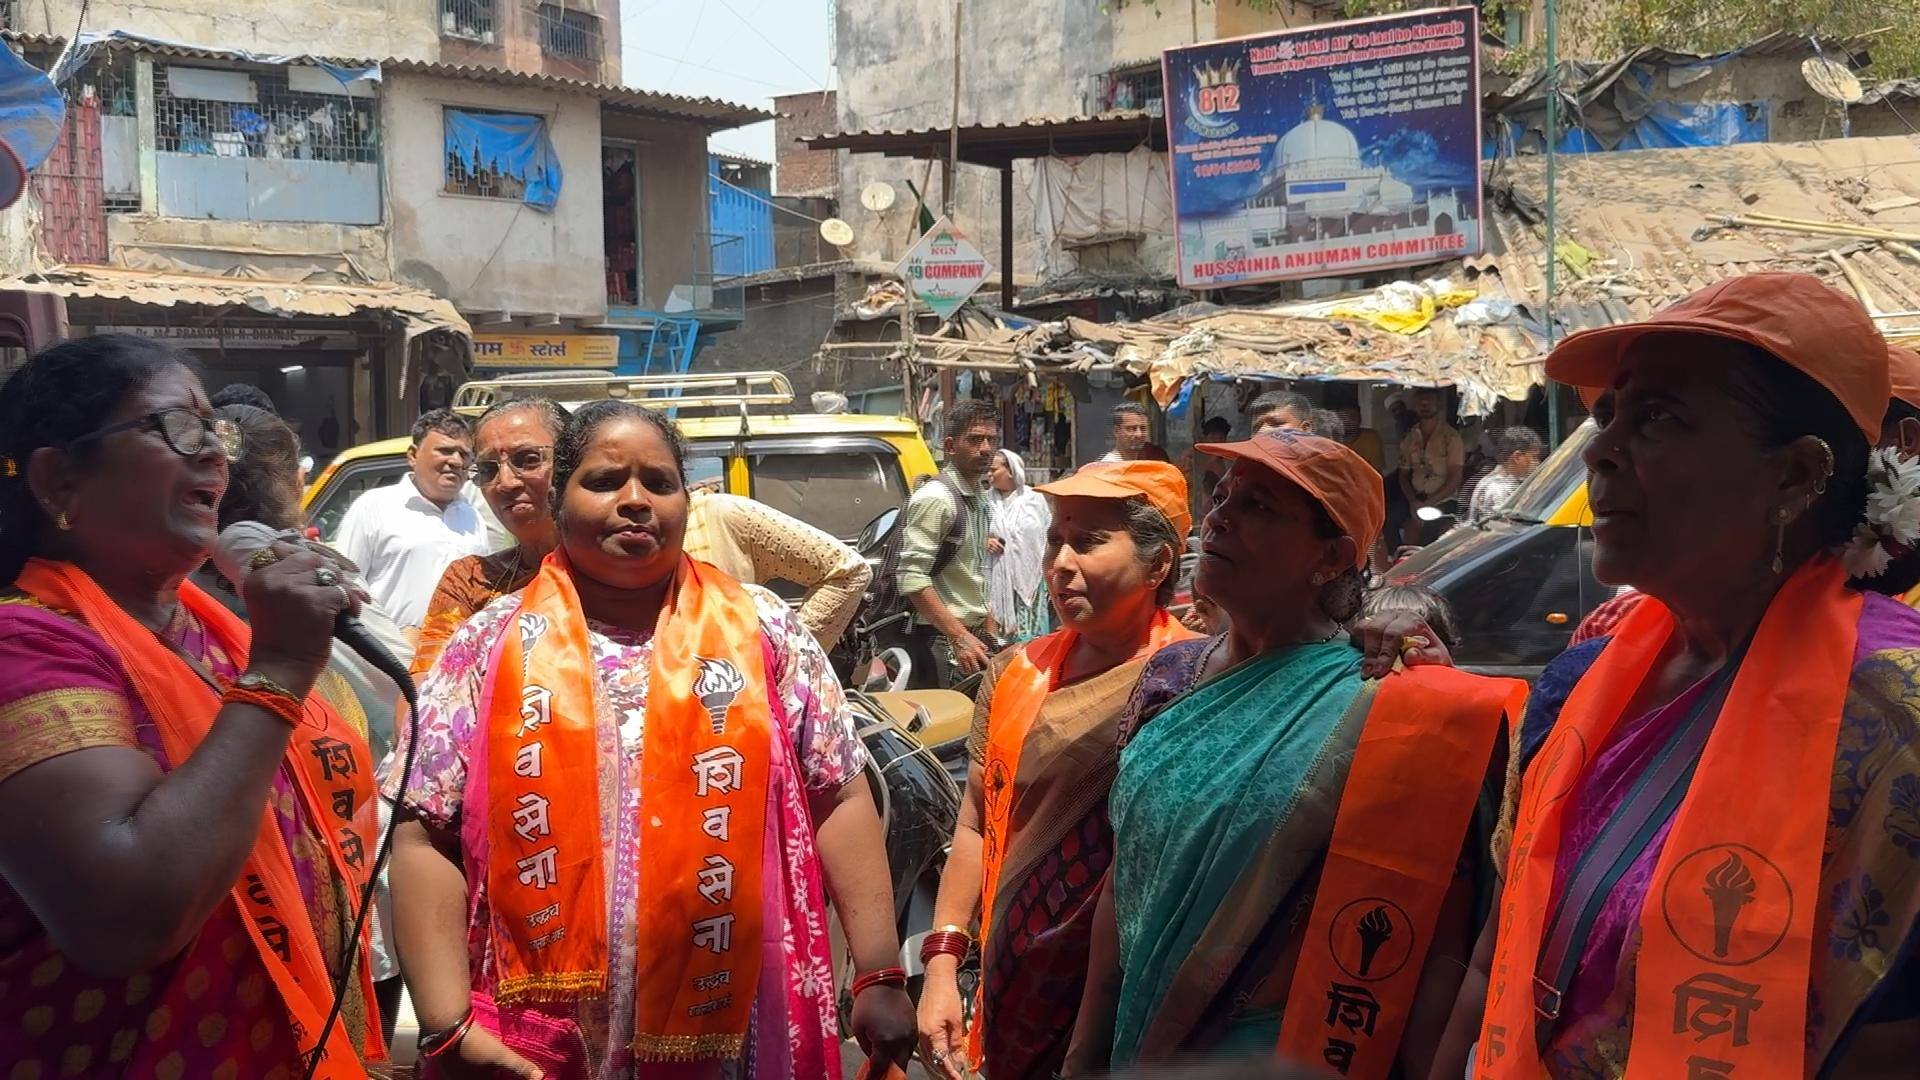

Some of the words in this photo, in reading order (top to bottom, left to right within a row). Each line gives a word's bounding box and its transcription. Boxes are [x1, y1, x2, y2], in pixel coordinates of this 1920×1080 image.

[1412, 20, 1465, 40] Khawaja
[1199, 85, 1240, 115] 812
[931, 246, 957, 255] KGN
[925, 263, 985, 279] COMPANY
[1193, 259, 1281, 278] HUSSAINIA
[1285, 247, 1362, 269] ANJUMAN
